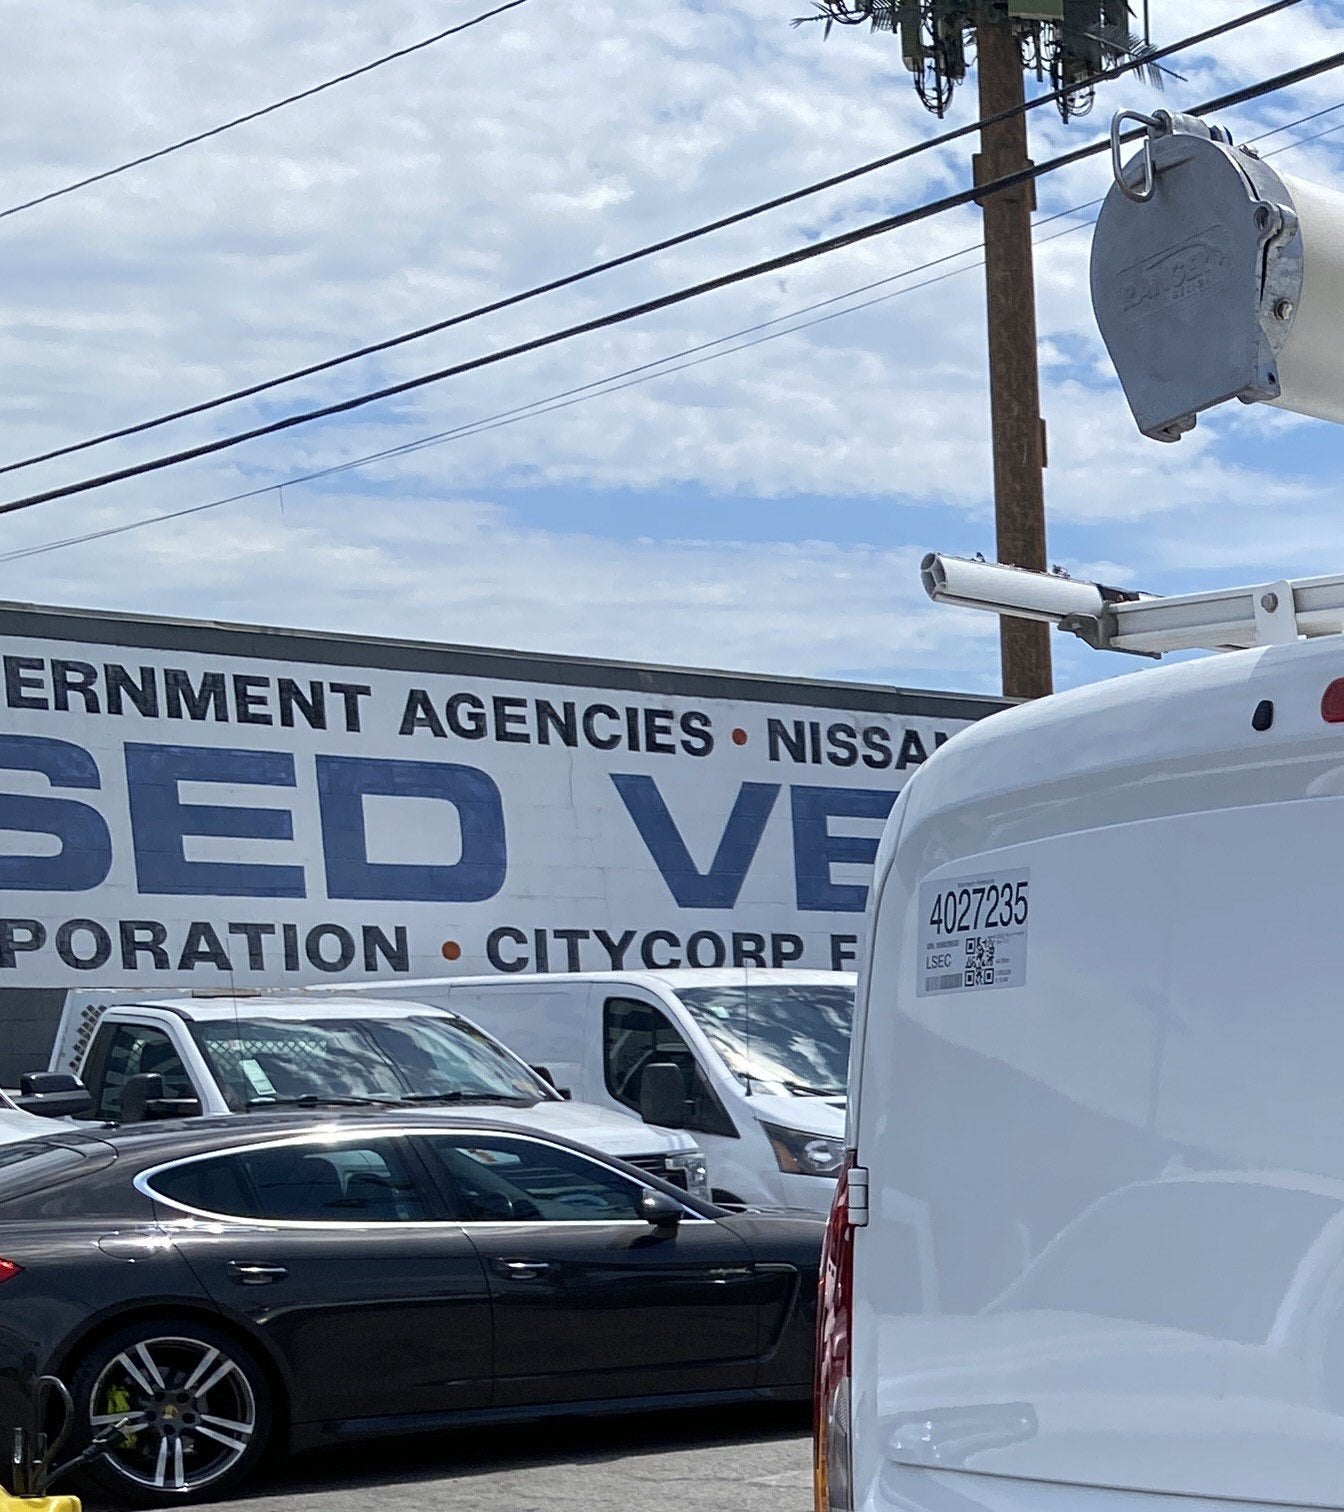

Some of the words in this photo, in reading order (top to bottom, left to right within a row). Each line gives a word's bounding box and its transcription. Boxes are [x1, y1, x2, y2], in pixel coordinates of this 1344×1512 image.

[3, 655, 372, 733] ERNMENT
[399, 688, 714, 757] AGENCIES
[930, 881, 1028, 934] 4027235
[0, 918, 410, 973] PORATION
[485, 928, 804, 972] CITYCORP
[926, 953, 952, 969] LSEC
